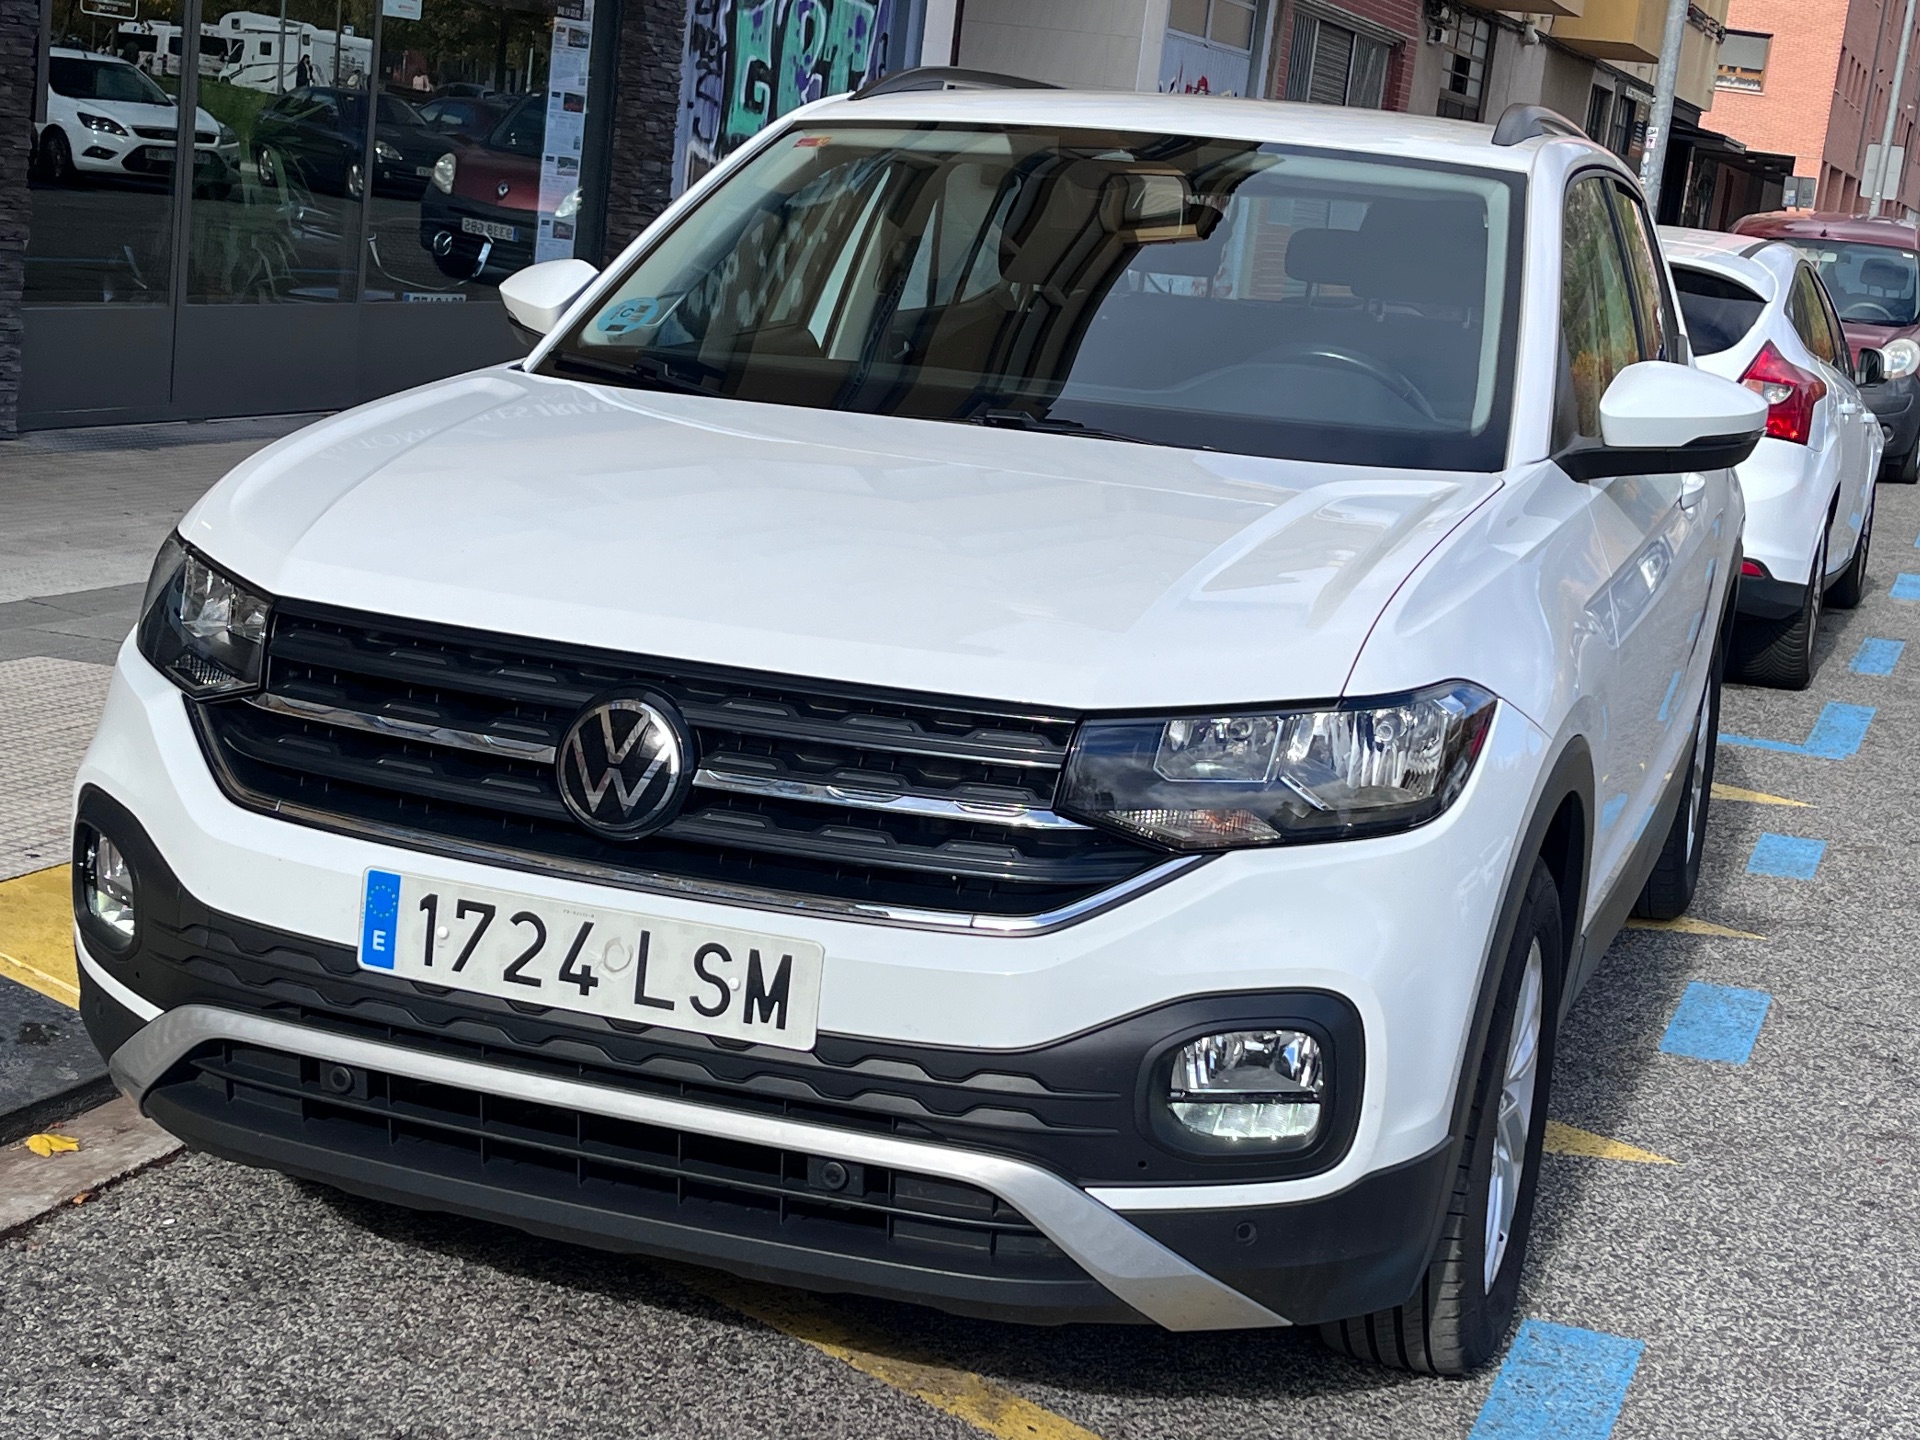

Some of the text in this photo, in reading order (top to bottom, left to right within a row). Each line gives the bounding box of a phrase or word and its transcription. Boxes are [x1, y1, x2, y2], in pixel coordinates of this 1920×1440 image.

[559, 699, 680, 828] VW
[372, 929, 386, 952] E
[419, 893, 793, 1030] 1724 LSM
